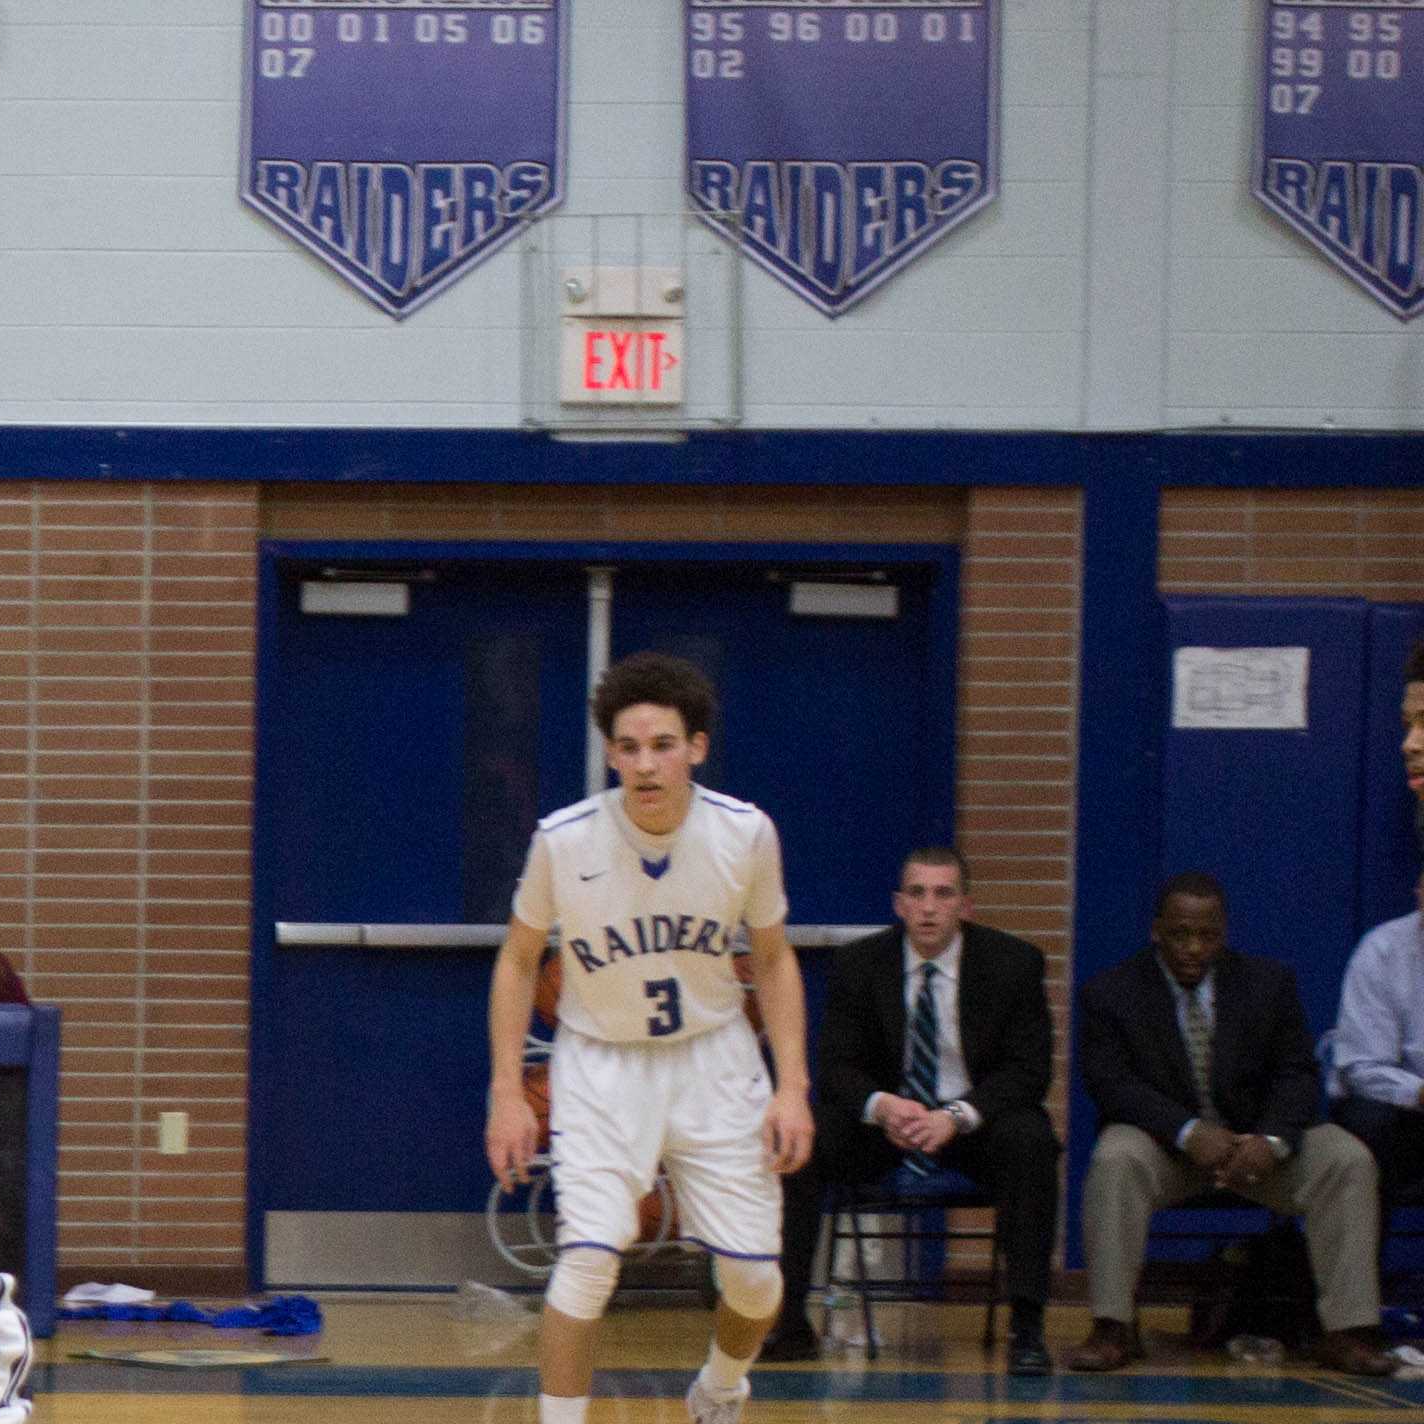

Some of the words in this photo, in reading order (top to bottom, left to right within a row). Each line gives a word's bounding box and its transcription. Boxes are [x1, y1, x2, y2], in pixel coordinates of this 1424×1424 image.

[259, 12, 314, 42] 00
[337, 13, 389, 43] 01
[414, 13, 468, 44] 05
[491, 14, 545, 44] 06
[692, 12, 745, 42] 95
[768, 12, 821, 42] 96
[844, 13, 898, 43] 00
[921, 13, 976, 43] 01
[1273, 10, 1323, 41] 94
[1348, 11, 1402, 42] 95
[259, 48, 315, 78] 07
[692, 48, 746, 79] 02
[1273, 48, 1323, 78] 99
[1348, 49, 1401, 79] 00
[1270, 83, 1322, 114] 07
[255, 160, 551, 298] RAIDERS
[690, 160, 983, 297] RAIDERS
[583, 331, 667, 391] EXIT
[645, 976, 683, 1037] 3
